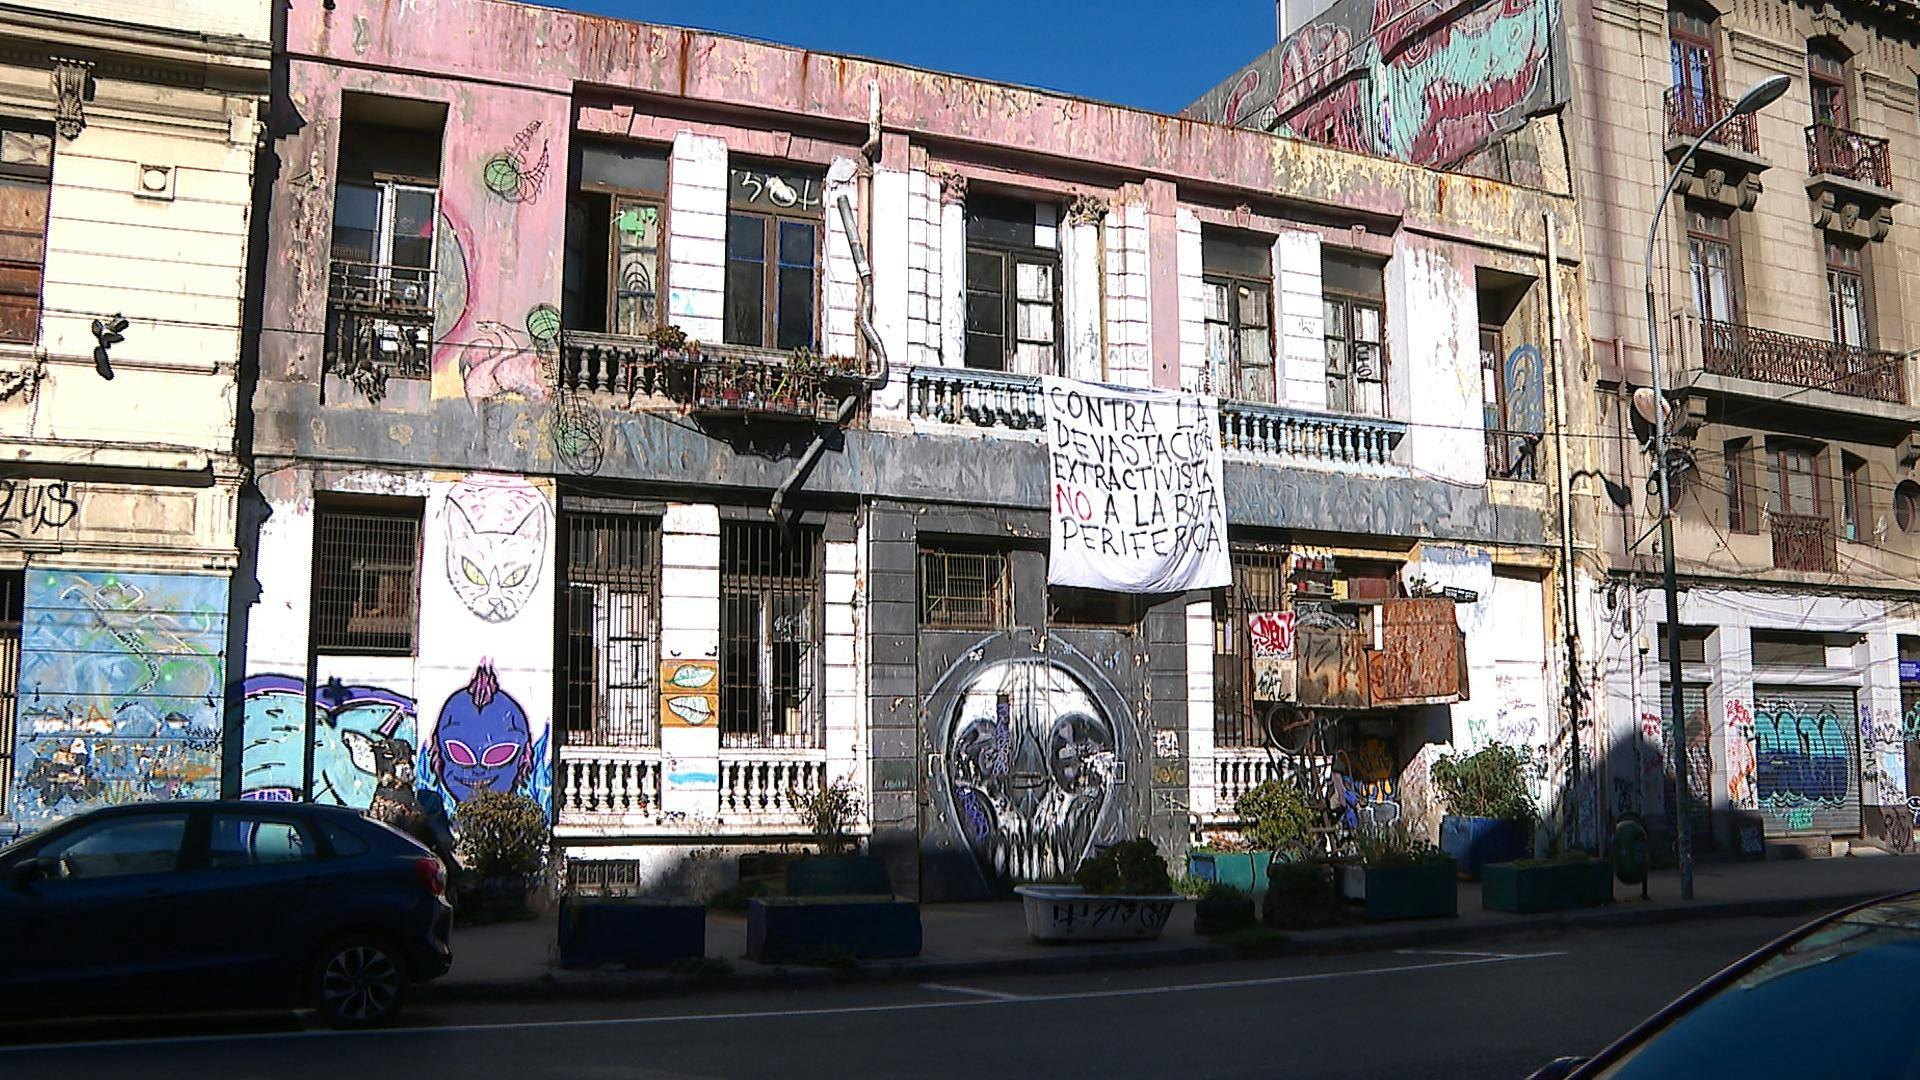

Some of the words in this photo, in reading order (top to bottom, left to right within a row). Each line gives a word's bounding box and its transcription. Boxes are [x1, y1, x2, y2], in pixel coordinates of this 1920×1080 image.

[1051, 387, 1158, 432] CONTRA
[1176, 397, 1209, 431] LA
[1052, 453, 1213, 491] EXTRACTIVISTA
[1056, 484, 1092, 521] NO
[1105, 494, 1119, 524] A
[1134, 492, 1166, 527] LA
